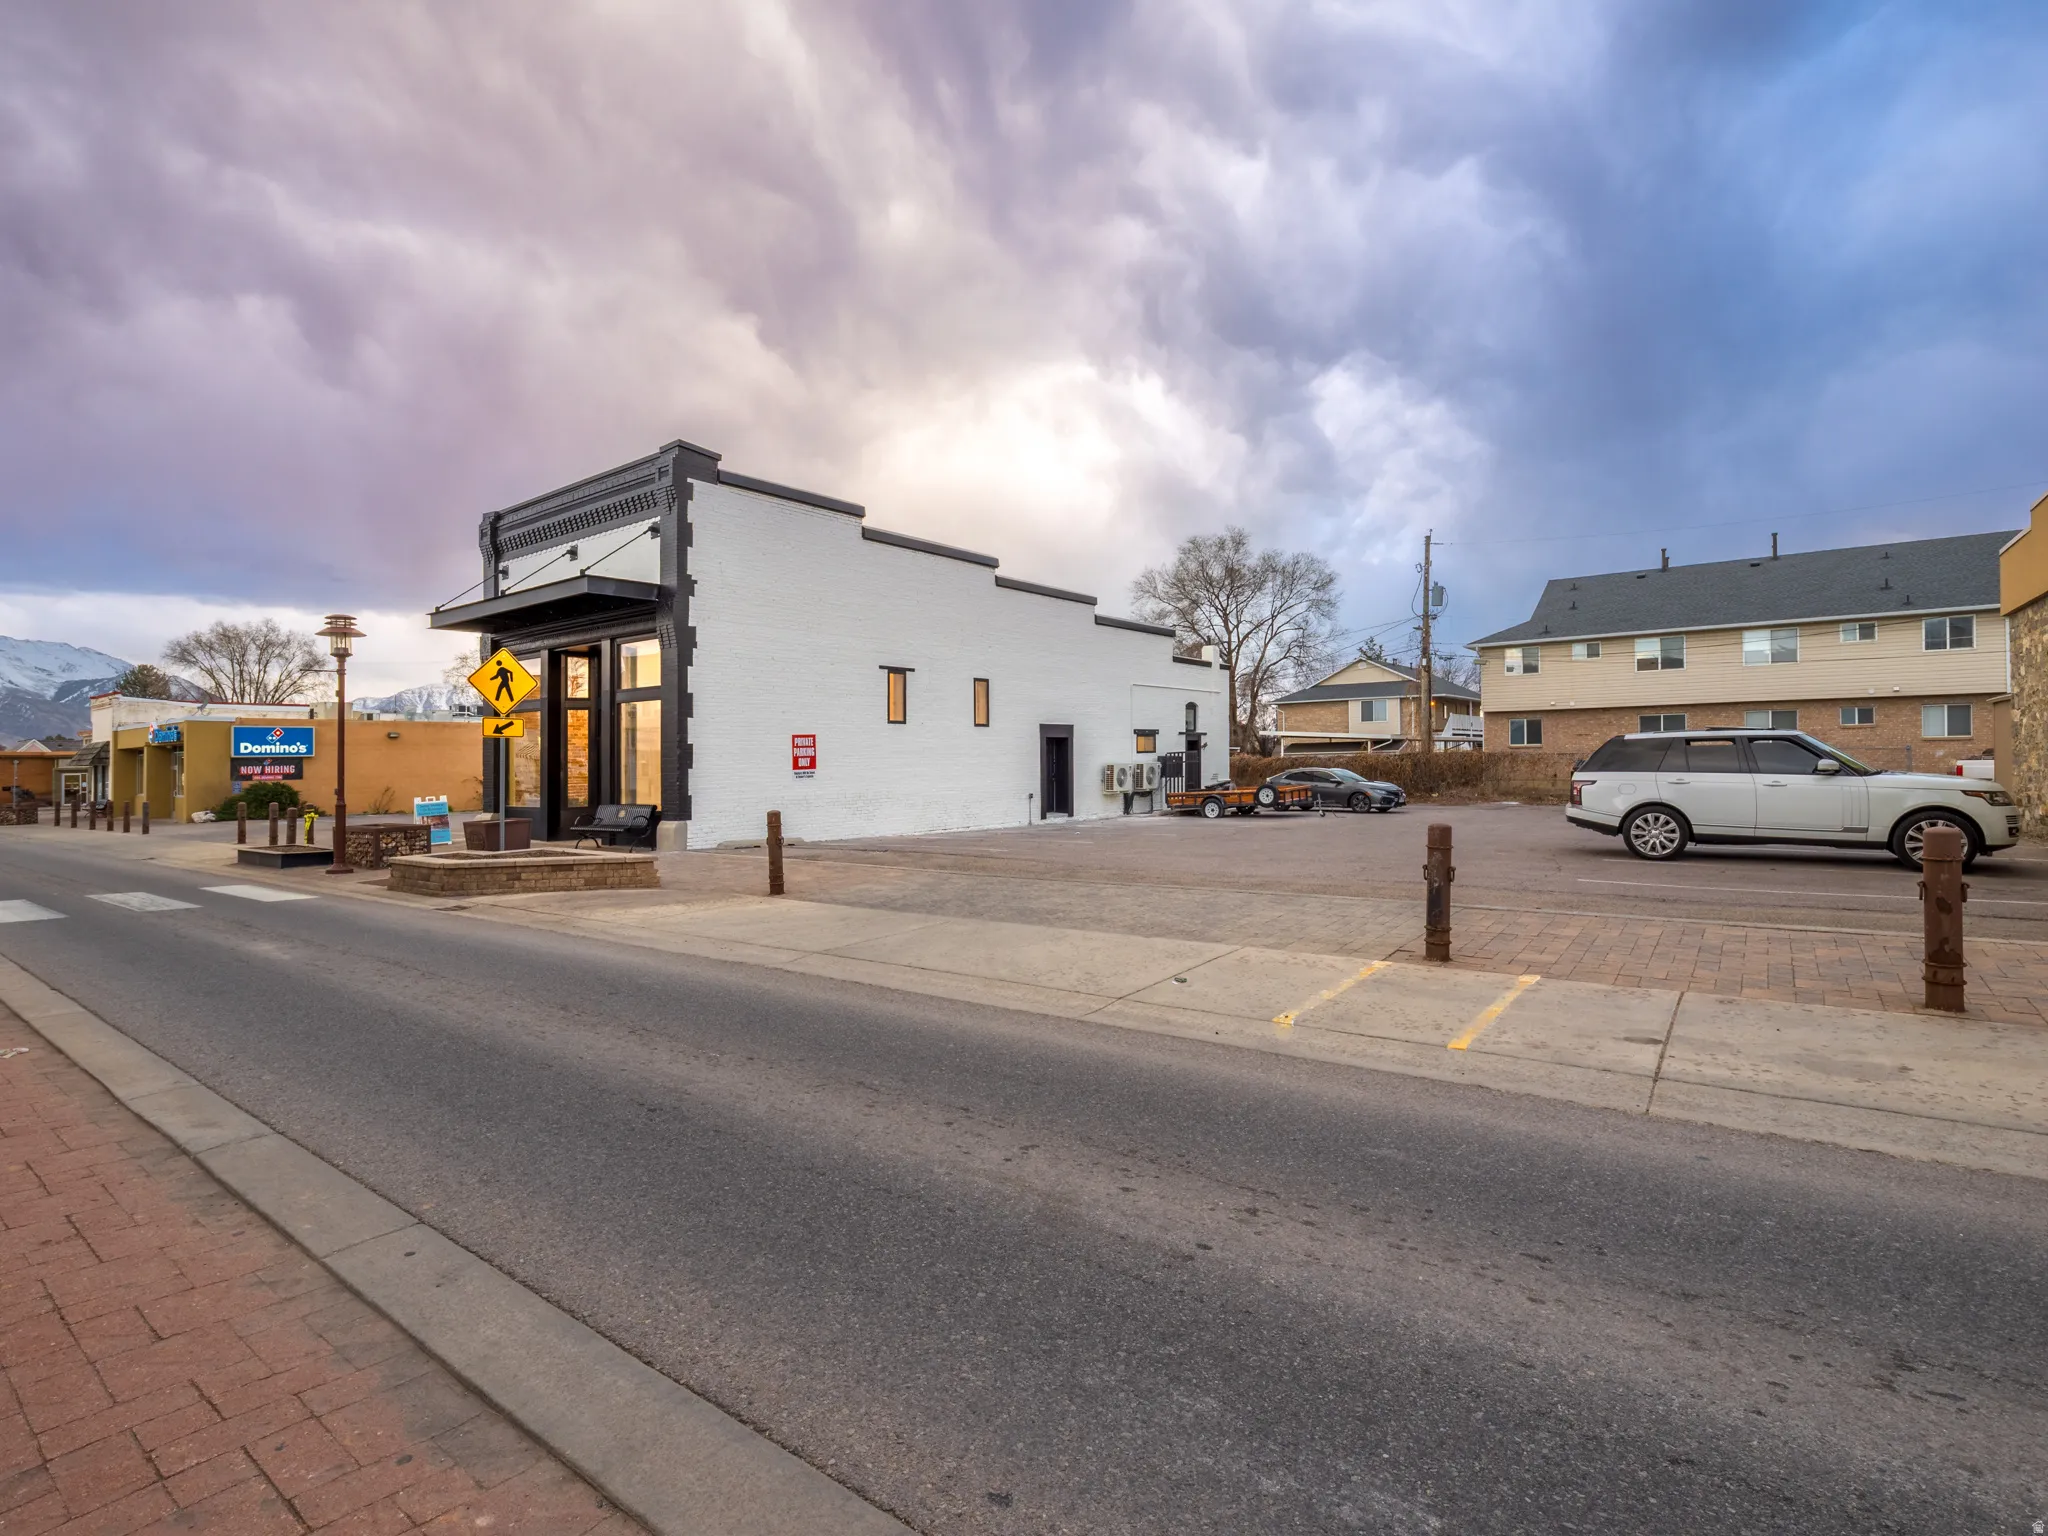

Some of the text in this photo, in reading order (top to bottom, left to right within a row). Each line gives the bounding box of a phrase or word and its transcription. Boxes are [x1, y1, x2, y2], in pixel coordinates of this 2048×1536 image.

[794, 738, 813, 746] PRIVATE
[240, 742, 307, 753] Domino's
[794, 748, 814, 756] PARKING
[798, 758, 810, 767] ONLY
[240, 765, 295, 774] NOW HIRING
